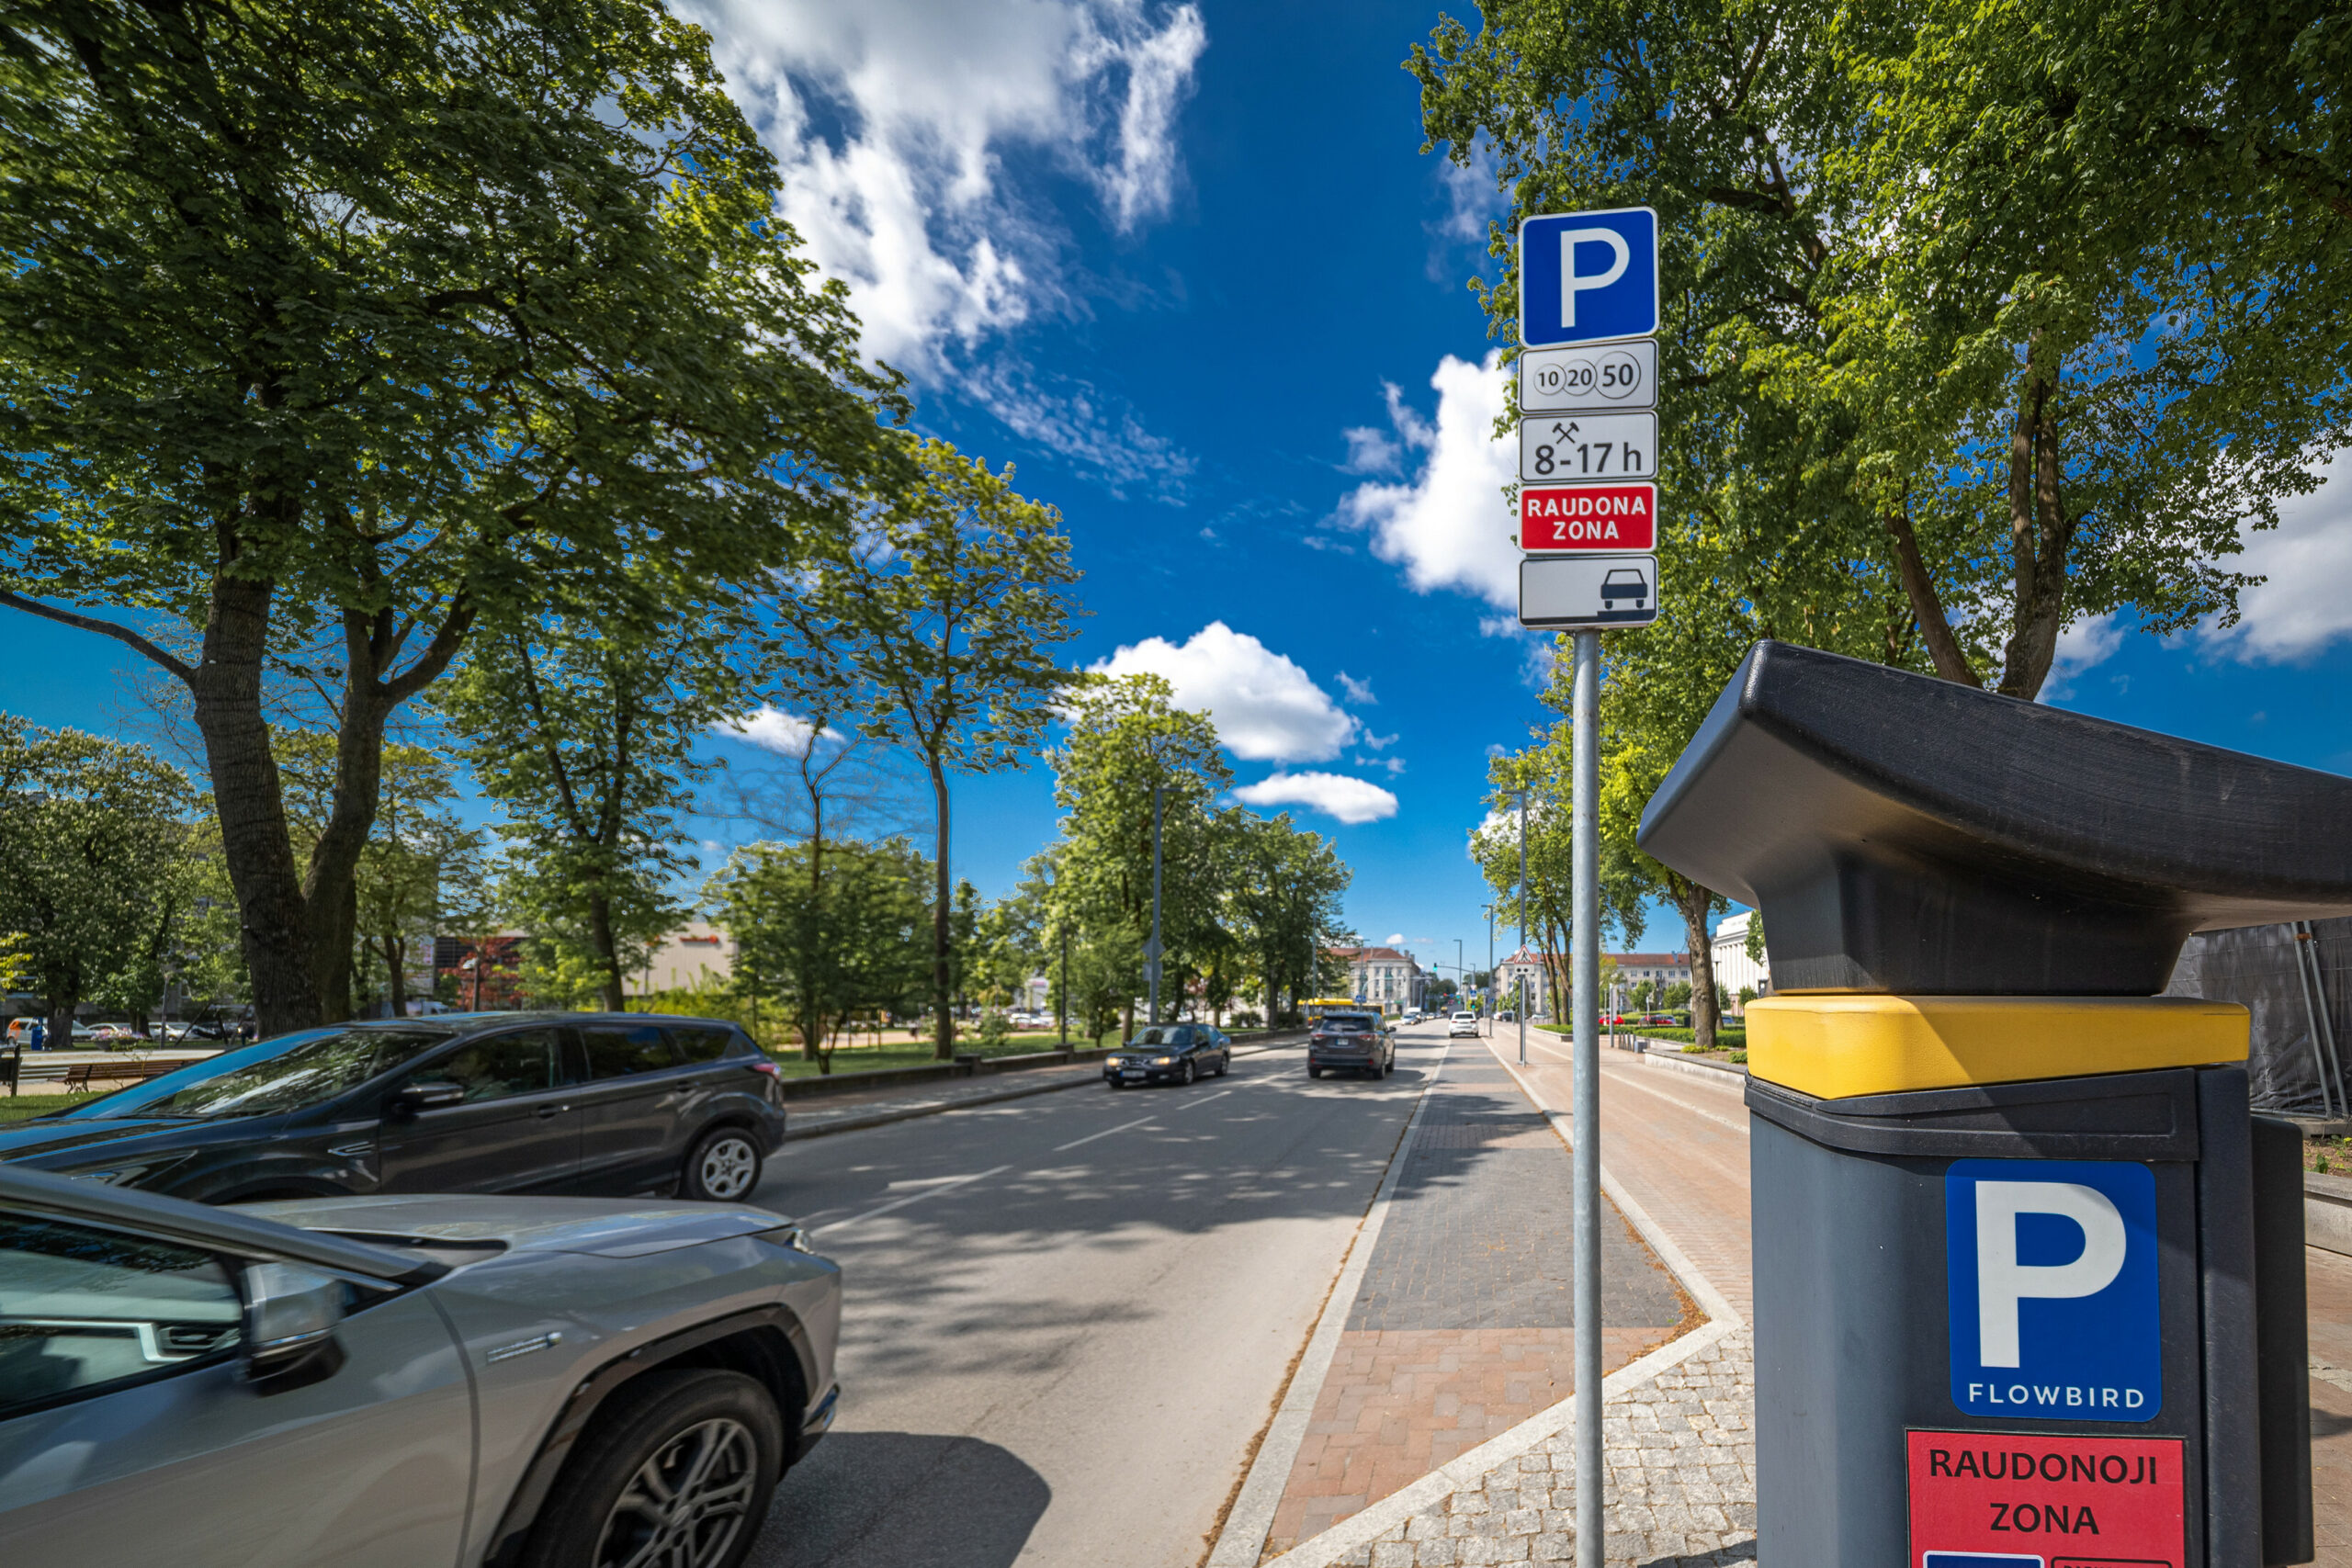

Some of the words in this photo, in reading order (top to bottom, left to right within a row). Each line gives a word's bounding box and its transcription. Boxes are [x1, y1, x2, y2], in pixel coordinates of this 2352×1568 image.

[1560, 227, 1630, 328] P
[1538, 371, 1559, 387] 10
[1567, 368, 1592, 387] 20
[1602, 363, 1634, 387] 50
[1535, 443, 1612, 475] 8-17
[1623, 442, 1641, 471] h
[1528, 496, 1646, 517] RAUDONA
[1553, 520, 1619, 540] ZONA
[1975, 1180, 2126, 1368] P
[1969, 1383, 2144, 1408] FLOWBIRD
[1929, 1449, 2157, 1485] RAUDONOJI
[1989, 1502, 2099, 1536] ZONA
